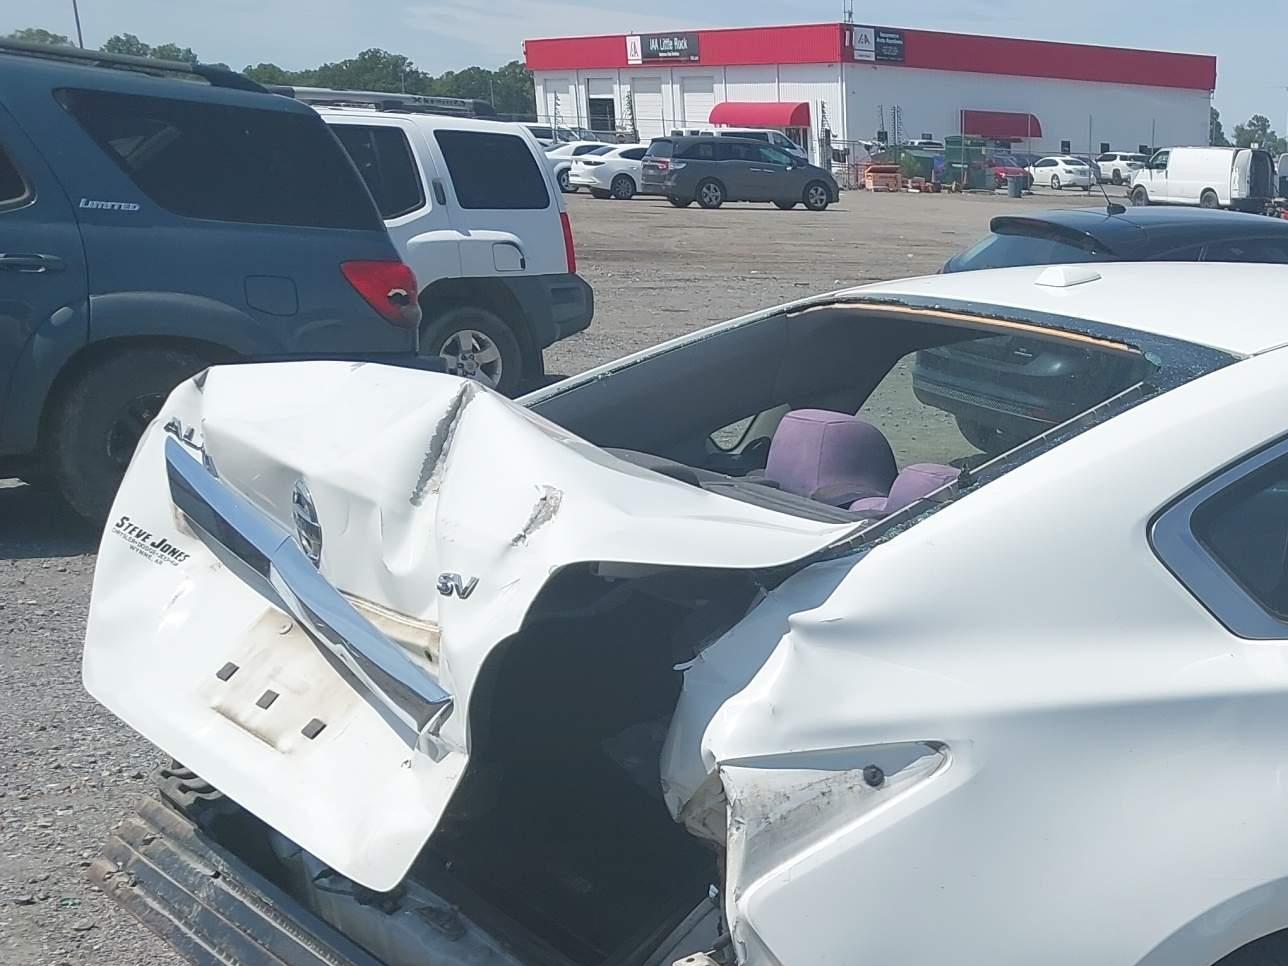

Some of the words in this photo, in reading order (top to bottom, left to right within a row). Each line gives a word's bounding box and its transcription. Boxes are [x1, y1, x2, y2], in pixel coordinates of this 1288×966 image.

[660, 37, 673, 51] Little
[674, 37, 688, 50] Rock
[80, 198, 140, 211] LIMITED
[115, 516, 153, 543] STEVE
[150, 538, 191, 562] JONES
[437, 573, 480, 599] SV
